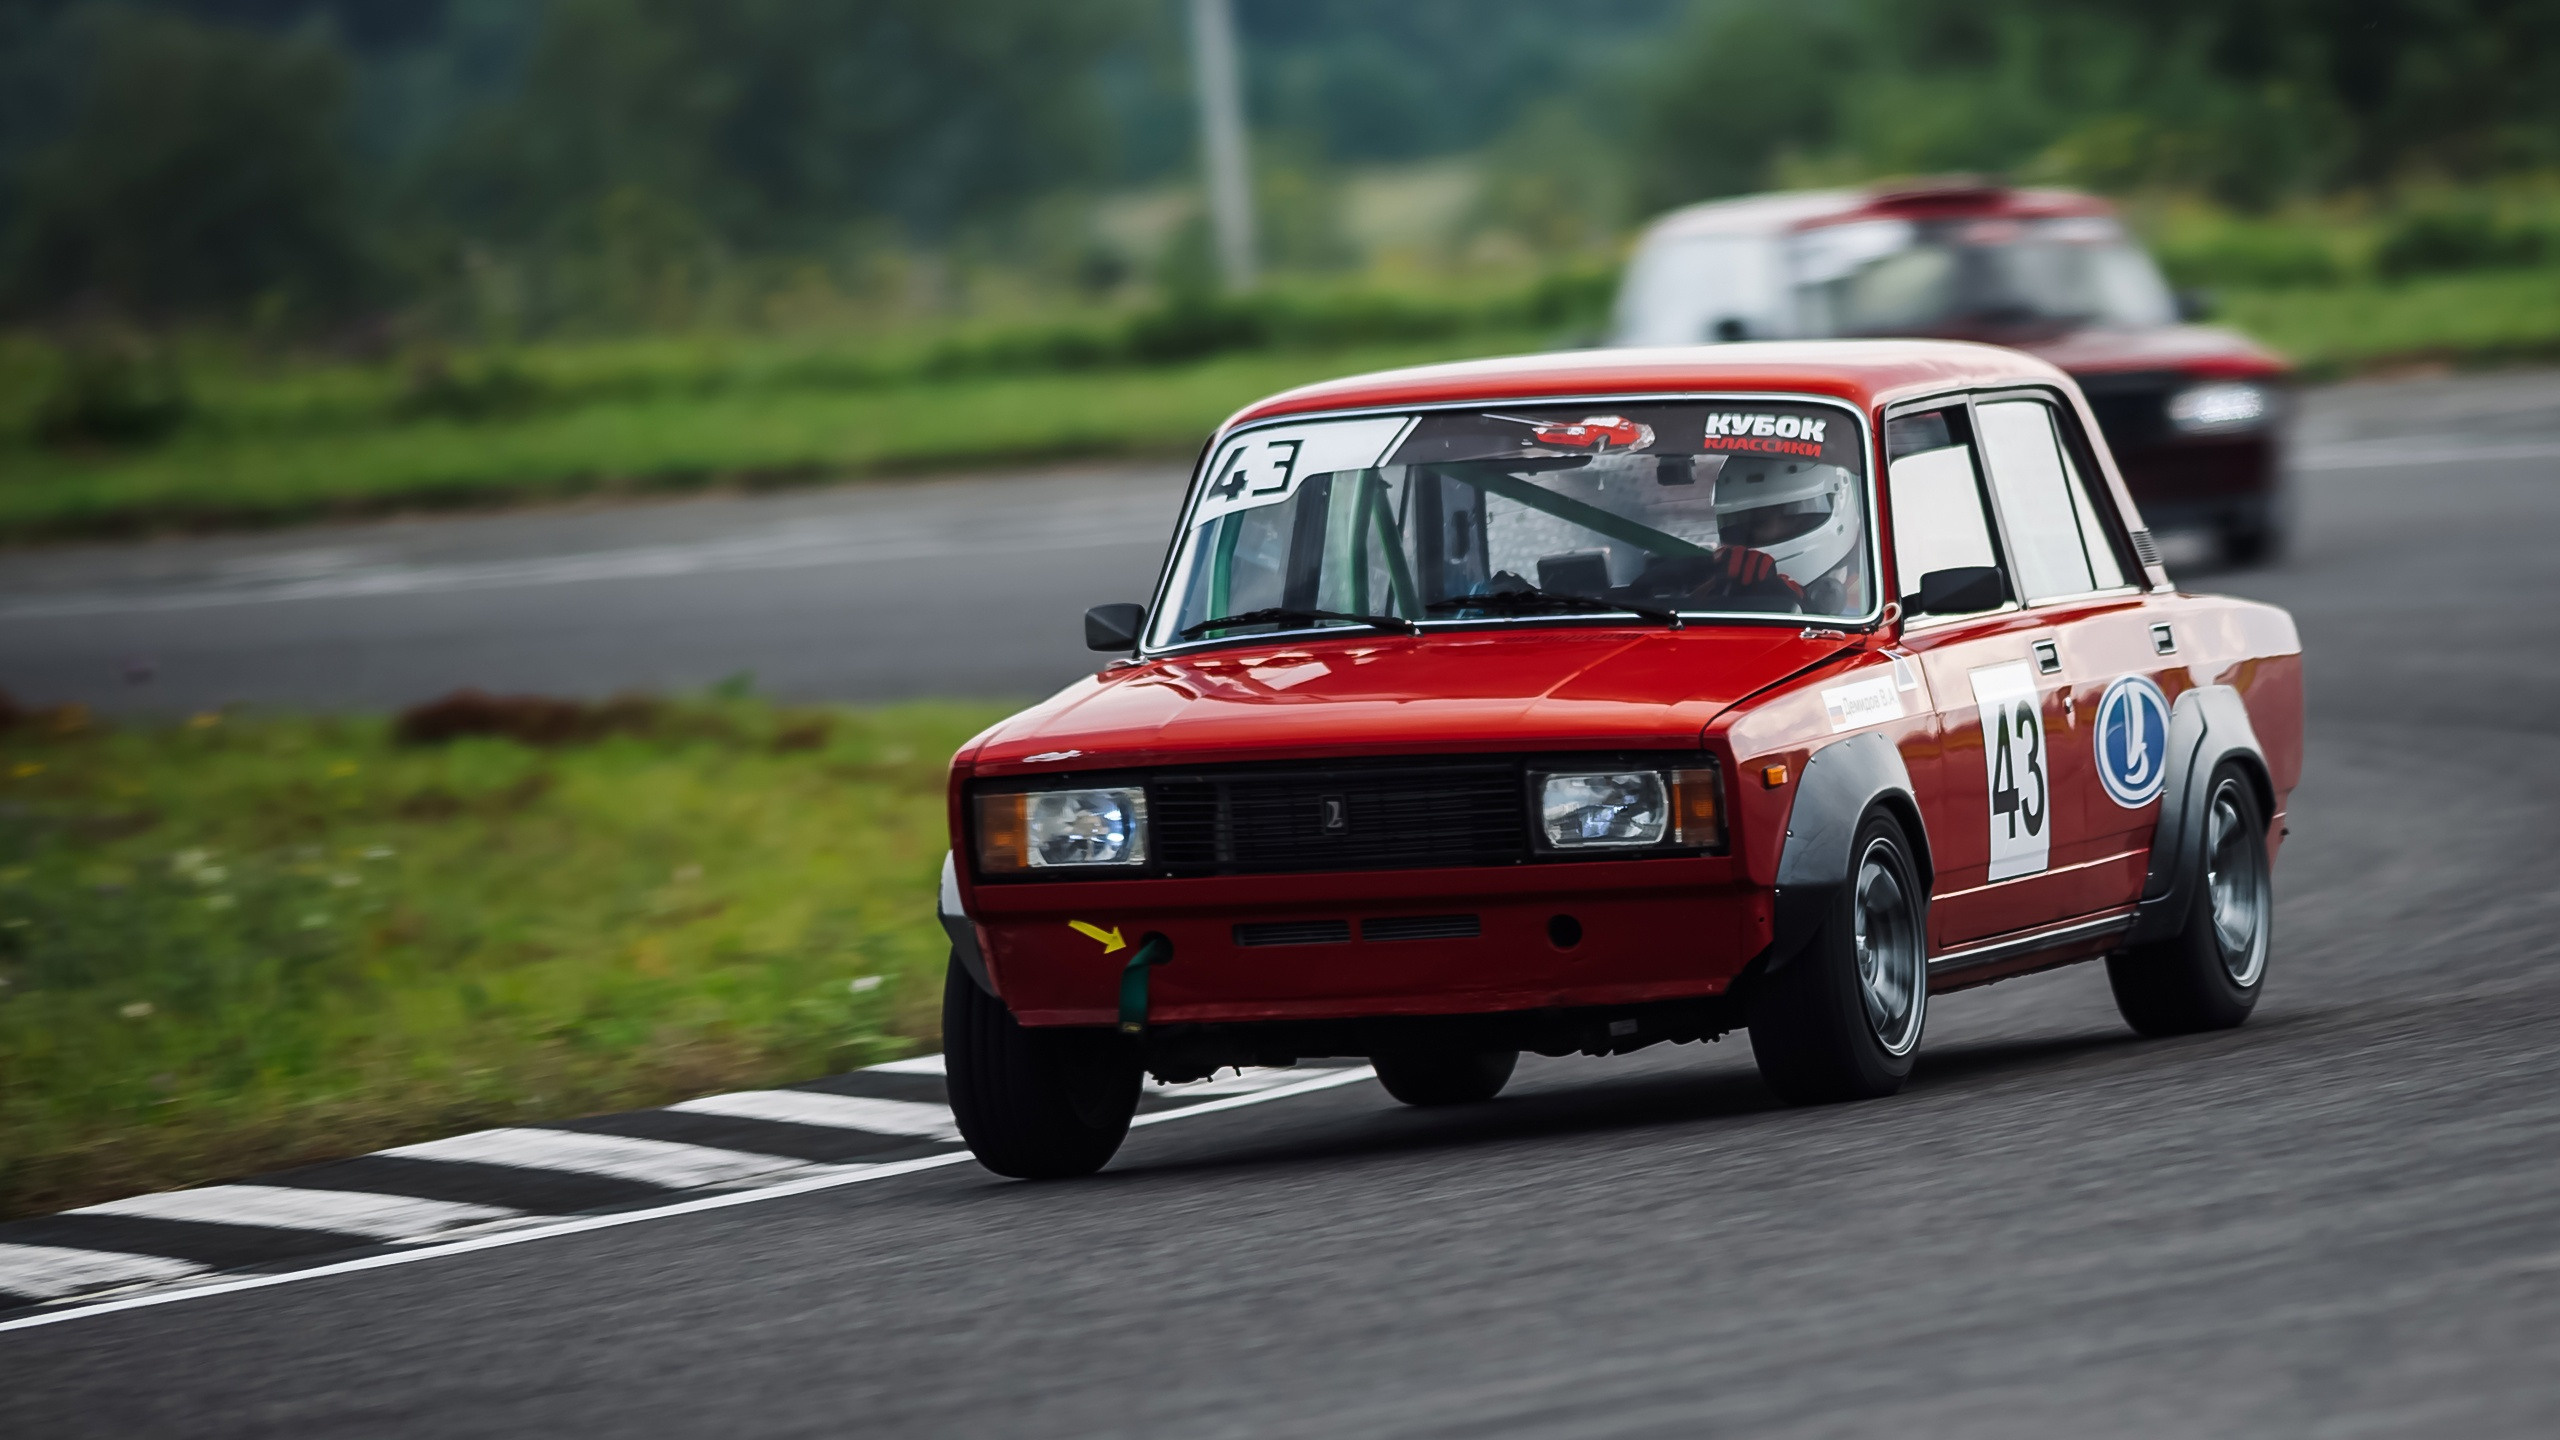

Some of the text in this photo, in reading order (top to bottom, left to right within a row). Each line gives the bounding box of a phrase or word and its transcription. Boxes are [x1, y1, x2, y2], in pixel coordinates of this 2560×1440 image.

[1703, 436, 1822, 458] КЛАССИКИ
[1705, 412, 1826, 443] КУБОК
[1206, 438, 1305, 502] 43
[1992, 699, 2045, 840] 43
